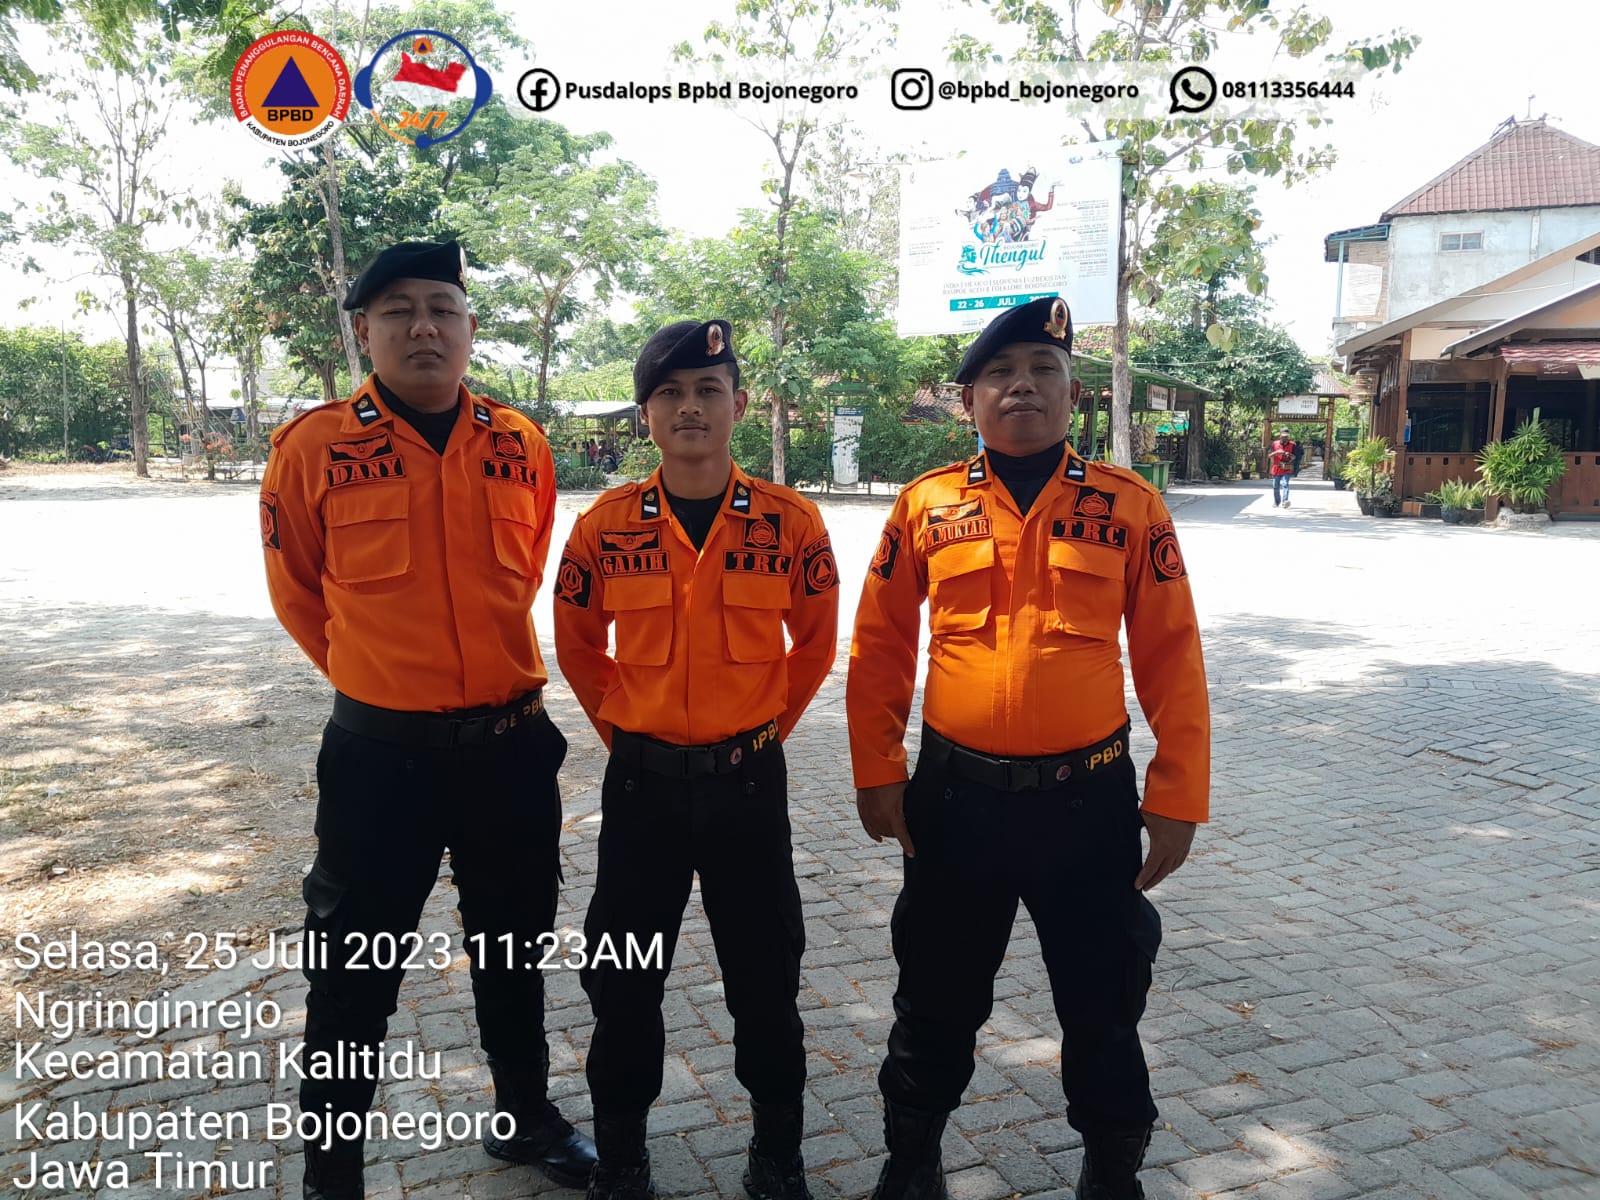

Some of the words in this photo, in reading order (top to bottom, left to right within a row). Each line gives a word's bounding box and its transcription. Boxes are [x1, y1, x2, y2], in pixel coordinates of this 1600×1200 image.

[980, 239, 1047, 271] Thengul
[997, 297, 1016, 306] JULI
[331, 459, 398, 485] DANY
[489, 461, 537, 484] TRC
[1061, 520, 1119, 544] TRC
[602, 554, 665, 575] GALIH
[732, 552, 786, 573] TRC
[1084, 740, 1123, 770] PBD
